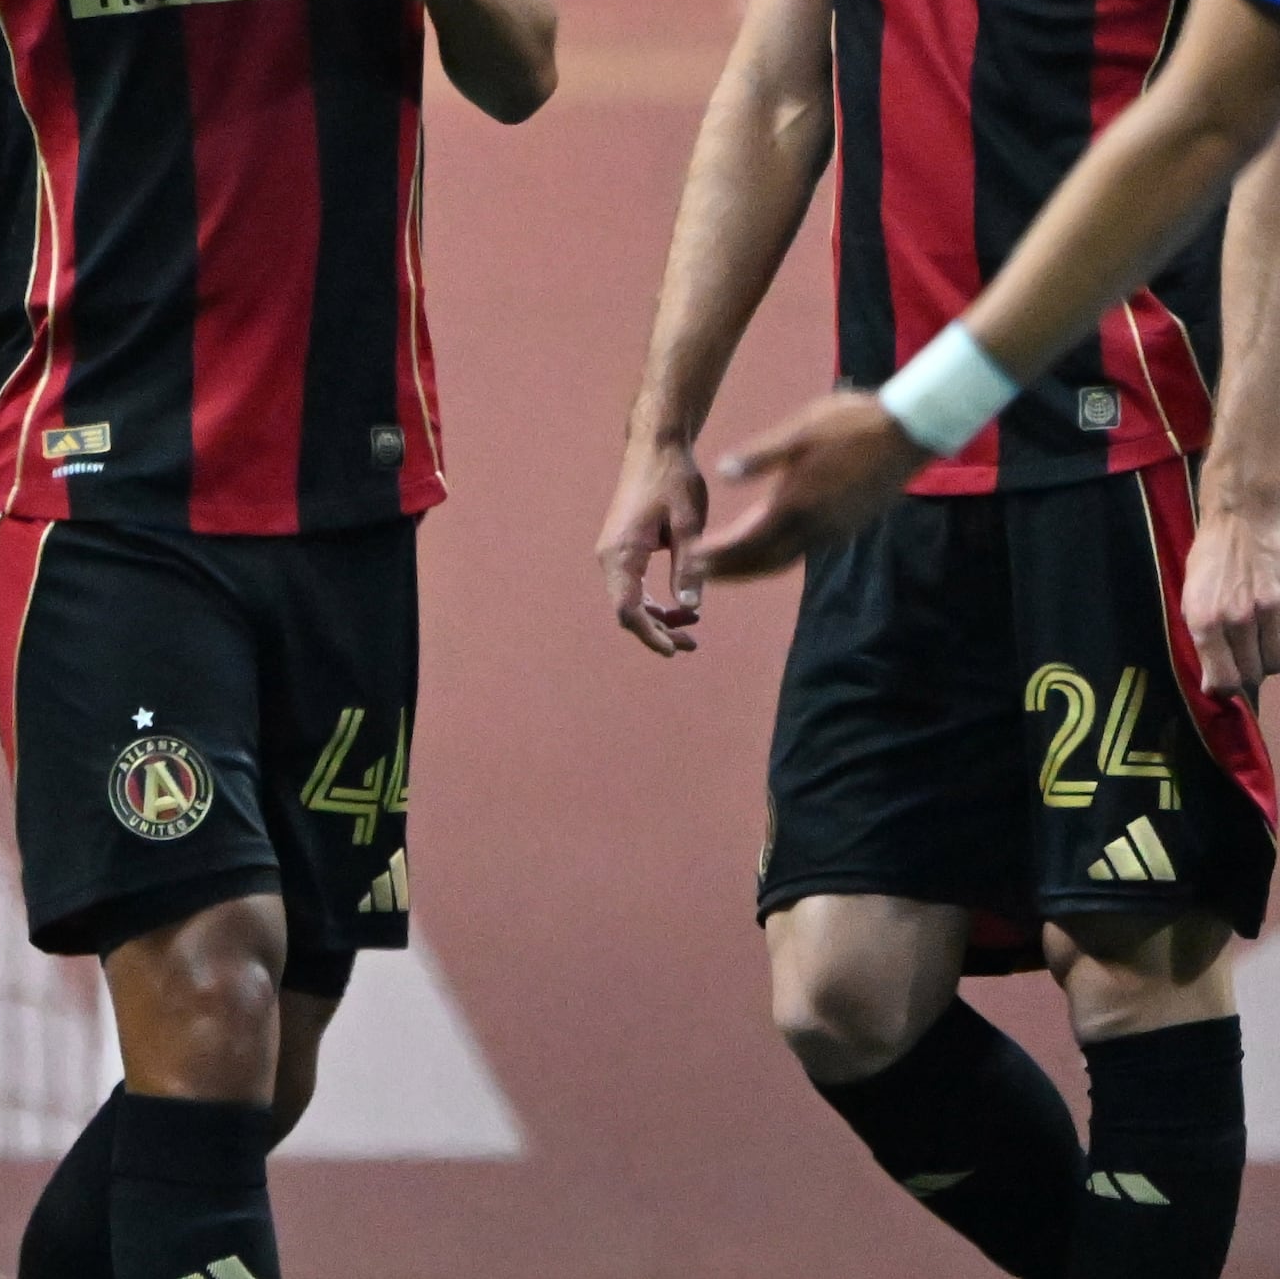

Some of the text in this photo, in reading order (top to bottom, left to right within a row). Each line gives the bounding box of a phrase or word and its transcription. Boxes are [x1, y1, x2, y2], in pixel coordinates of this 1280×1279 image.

[1024, 662, 1181, 810] 24
[120, 740, 188, 772] ATLANTA
[129, 815, 187, 836] UNITED
